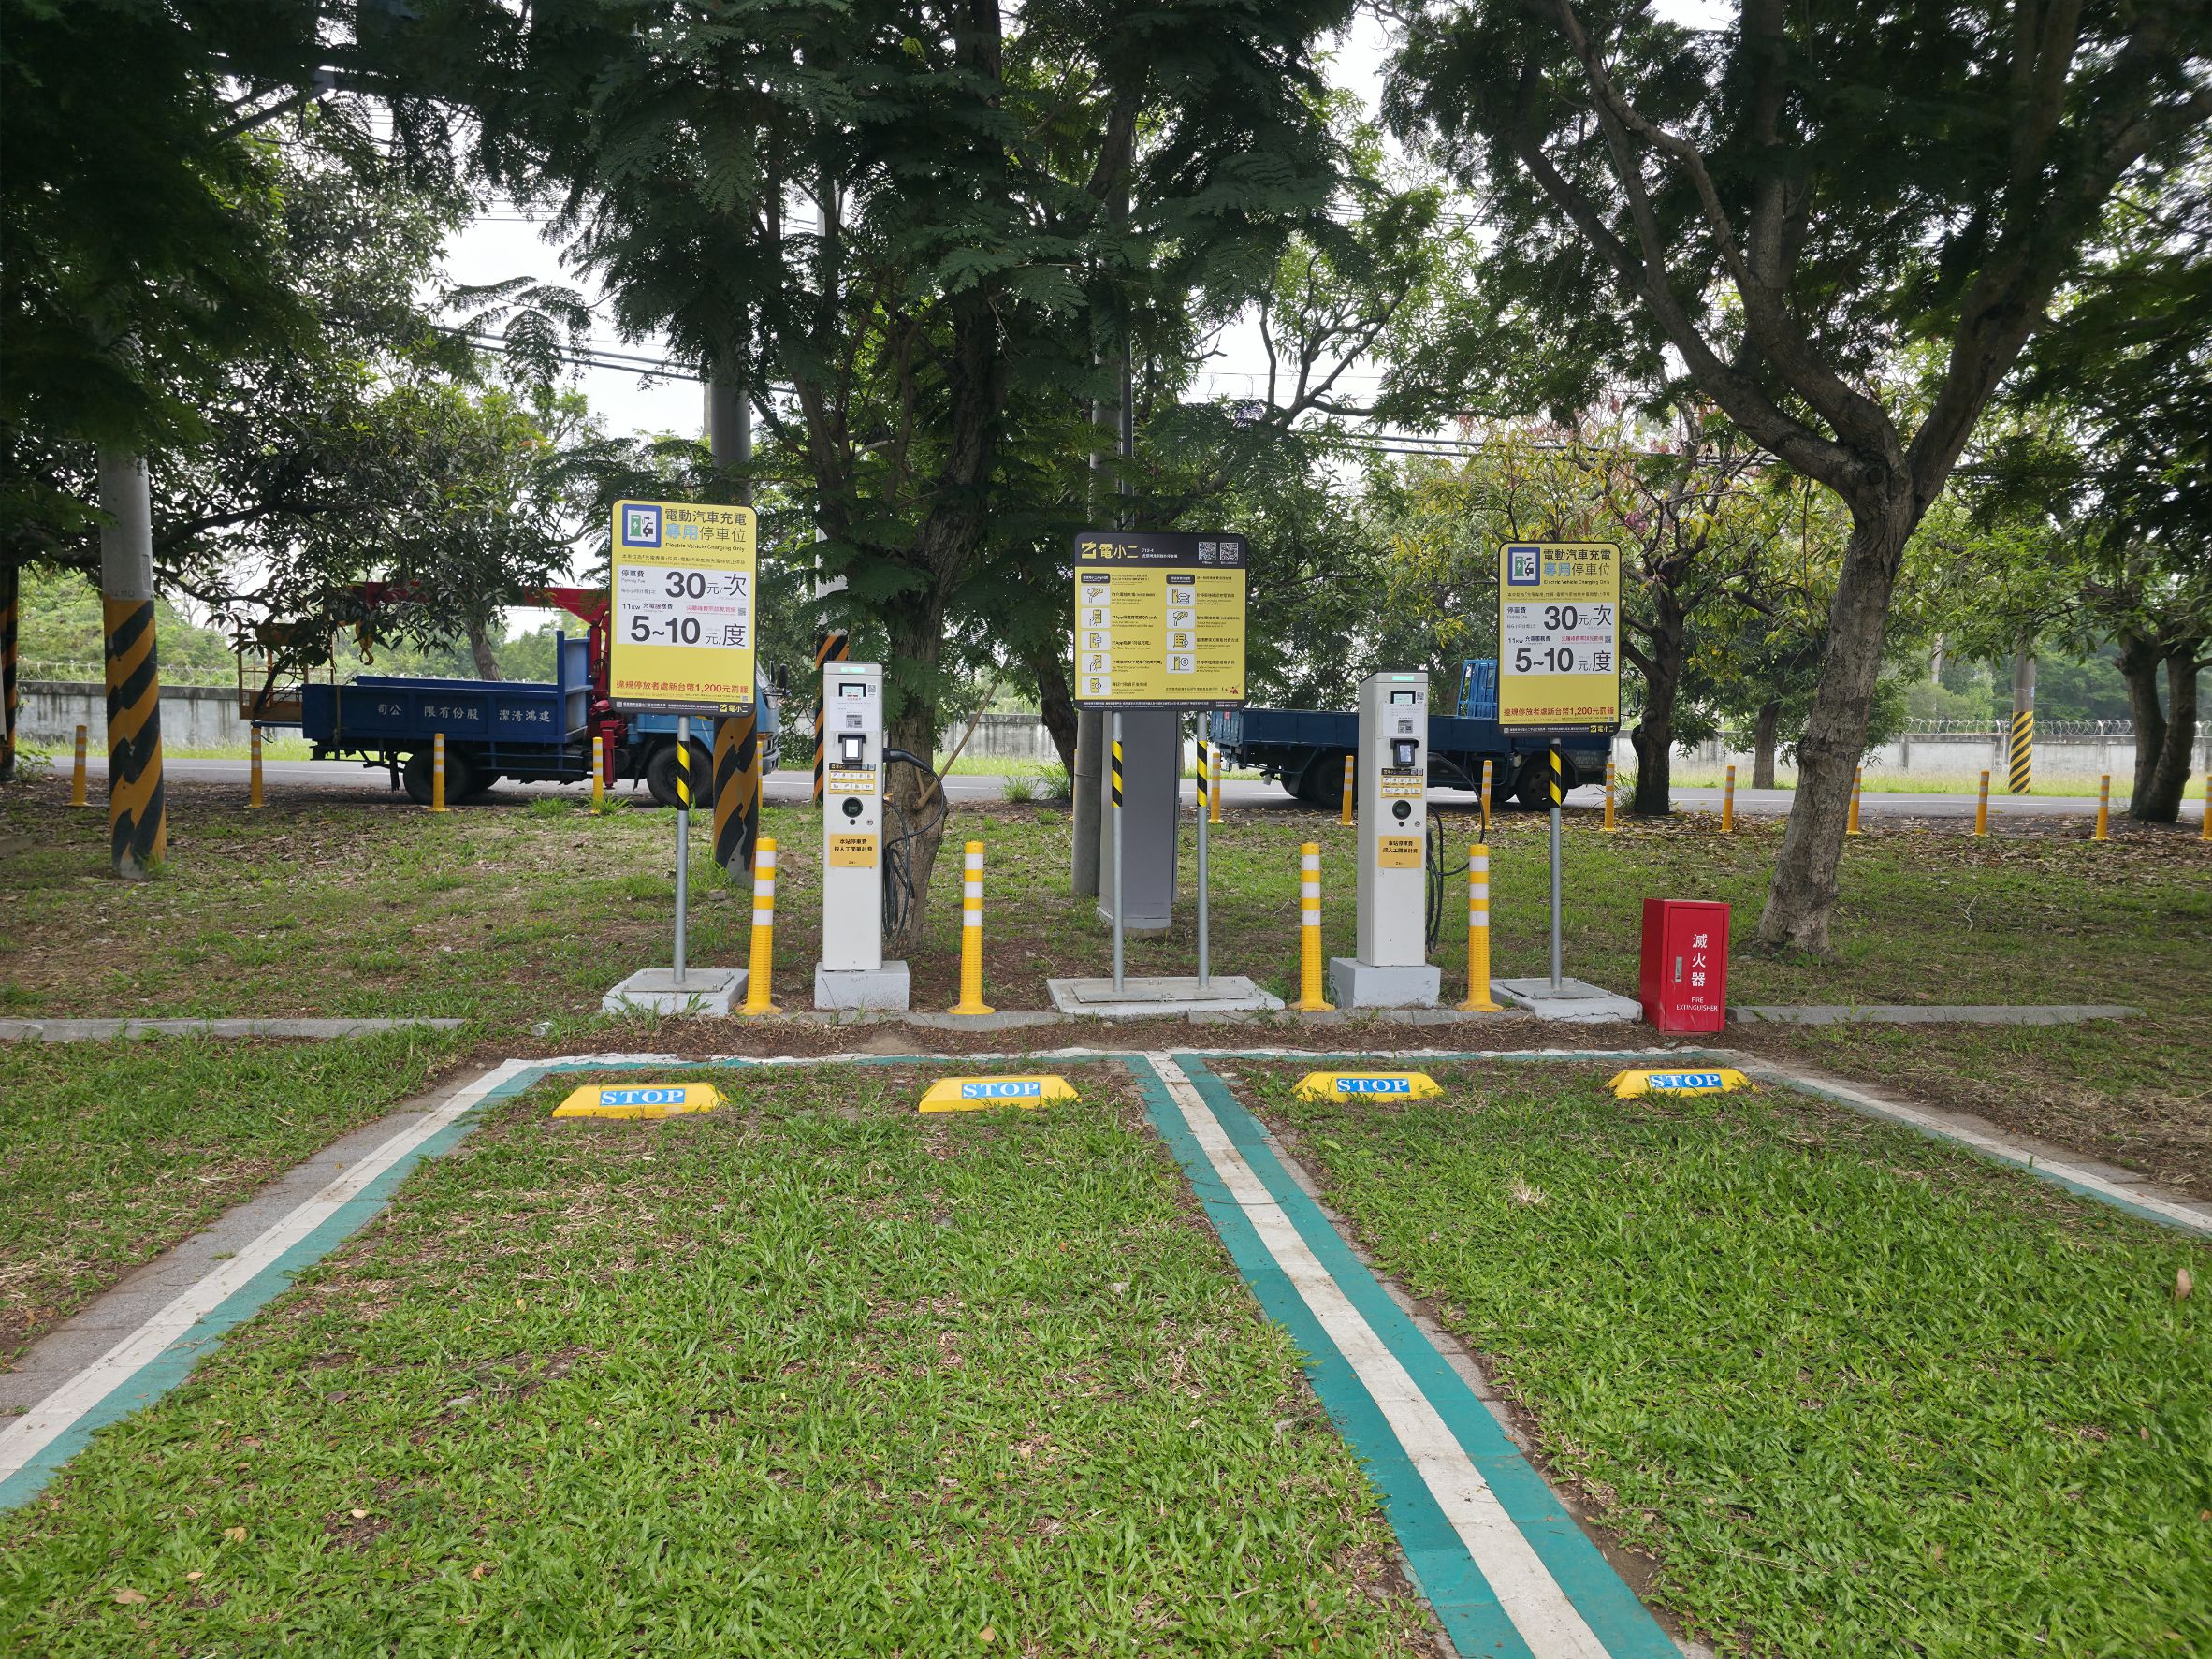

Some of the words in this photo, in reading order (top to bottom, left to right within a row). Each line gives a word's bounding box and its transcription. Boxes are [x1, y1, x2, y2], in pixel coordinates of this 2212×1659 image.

[665, 508, 747, 526] 電動汽車充電
[665, 523, 746, 543] 專用停車位
[1099, 543, 1139, 559] 電小二
[1543, 548, 1611, 561] 電動汽車充電
[1543, 562, 1611, 576] 專用停車位
[728, 704, 749, 713] 電小二
[1691, 933, 1708, 987] 滅火器
[1337, 1079, 1408, 1092] STOP
[1651, 1075, 1720, 1087] STOP
[601, 1089, 684, 1105] STOP
[963, 1083, 1039, 1098] STOP
